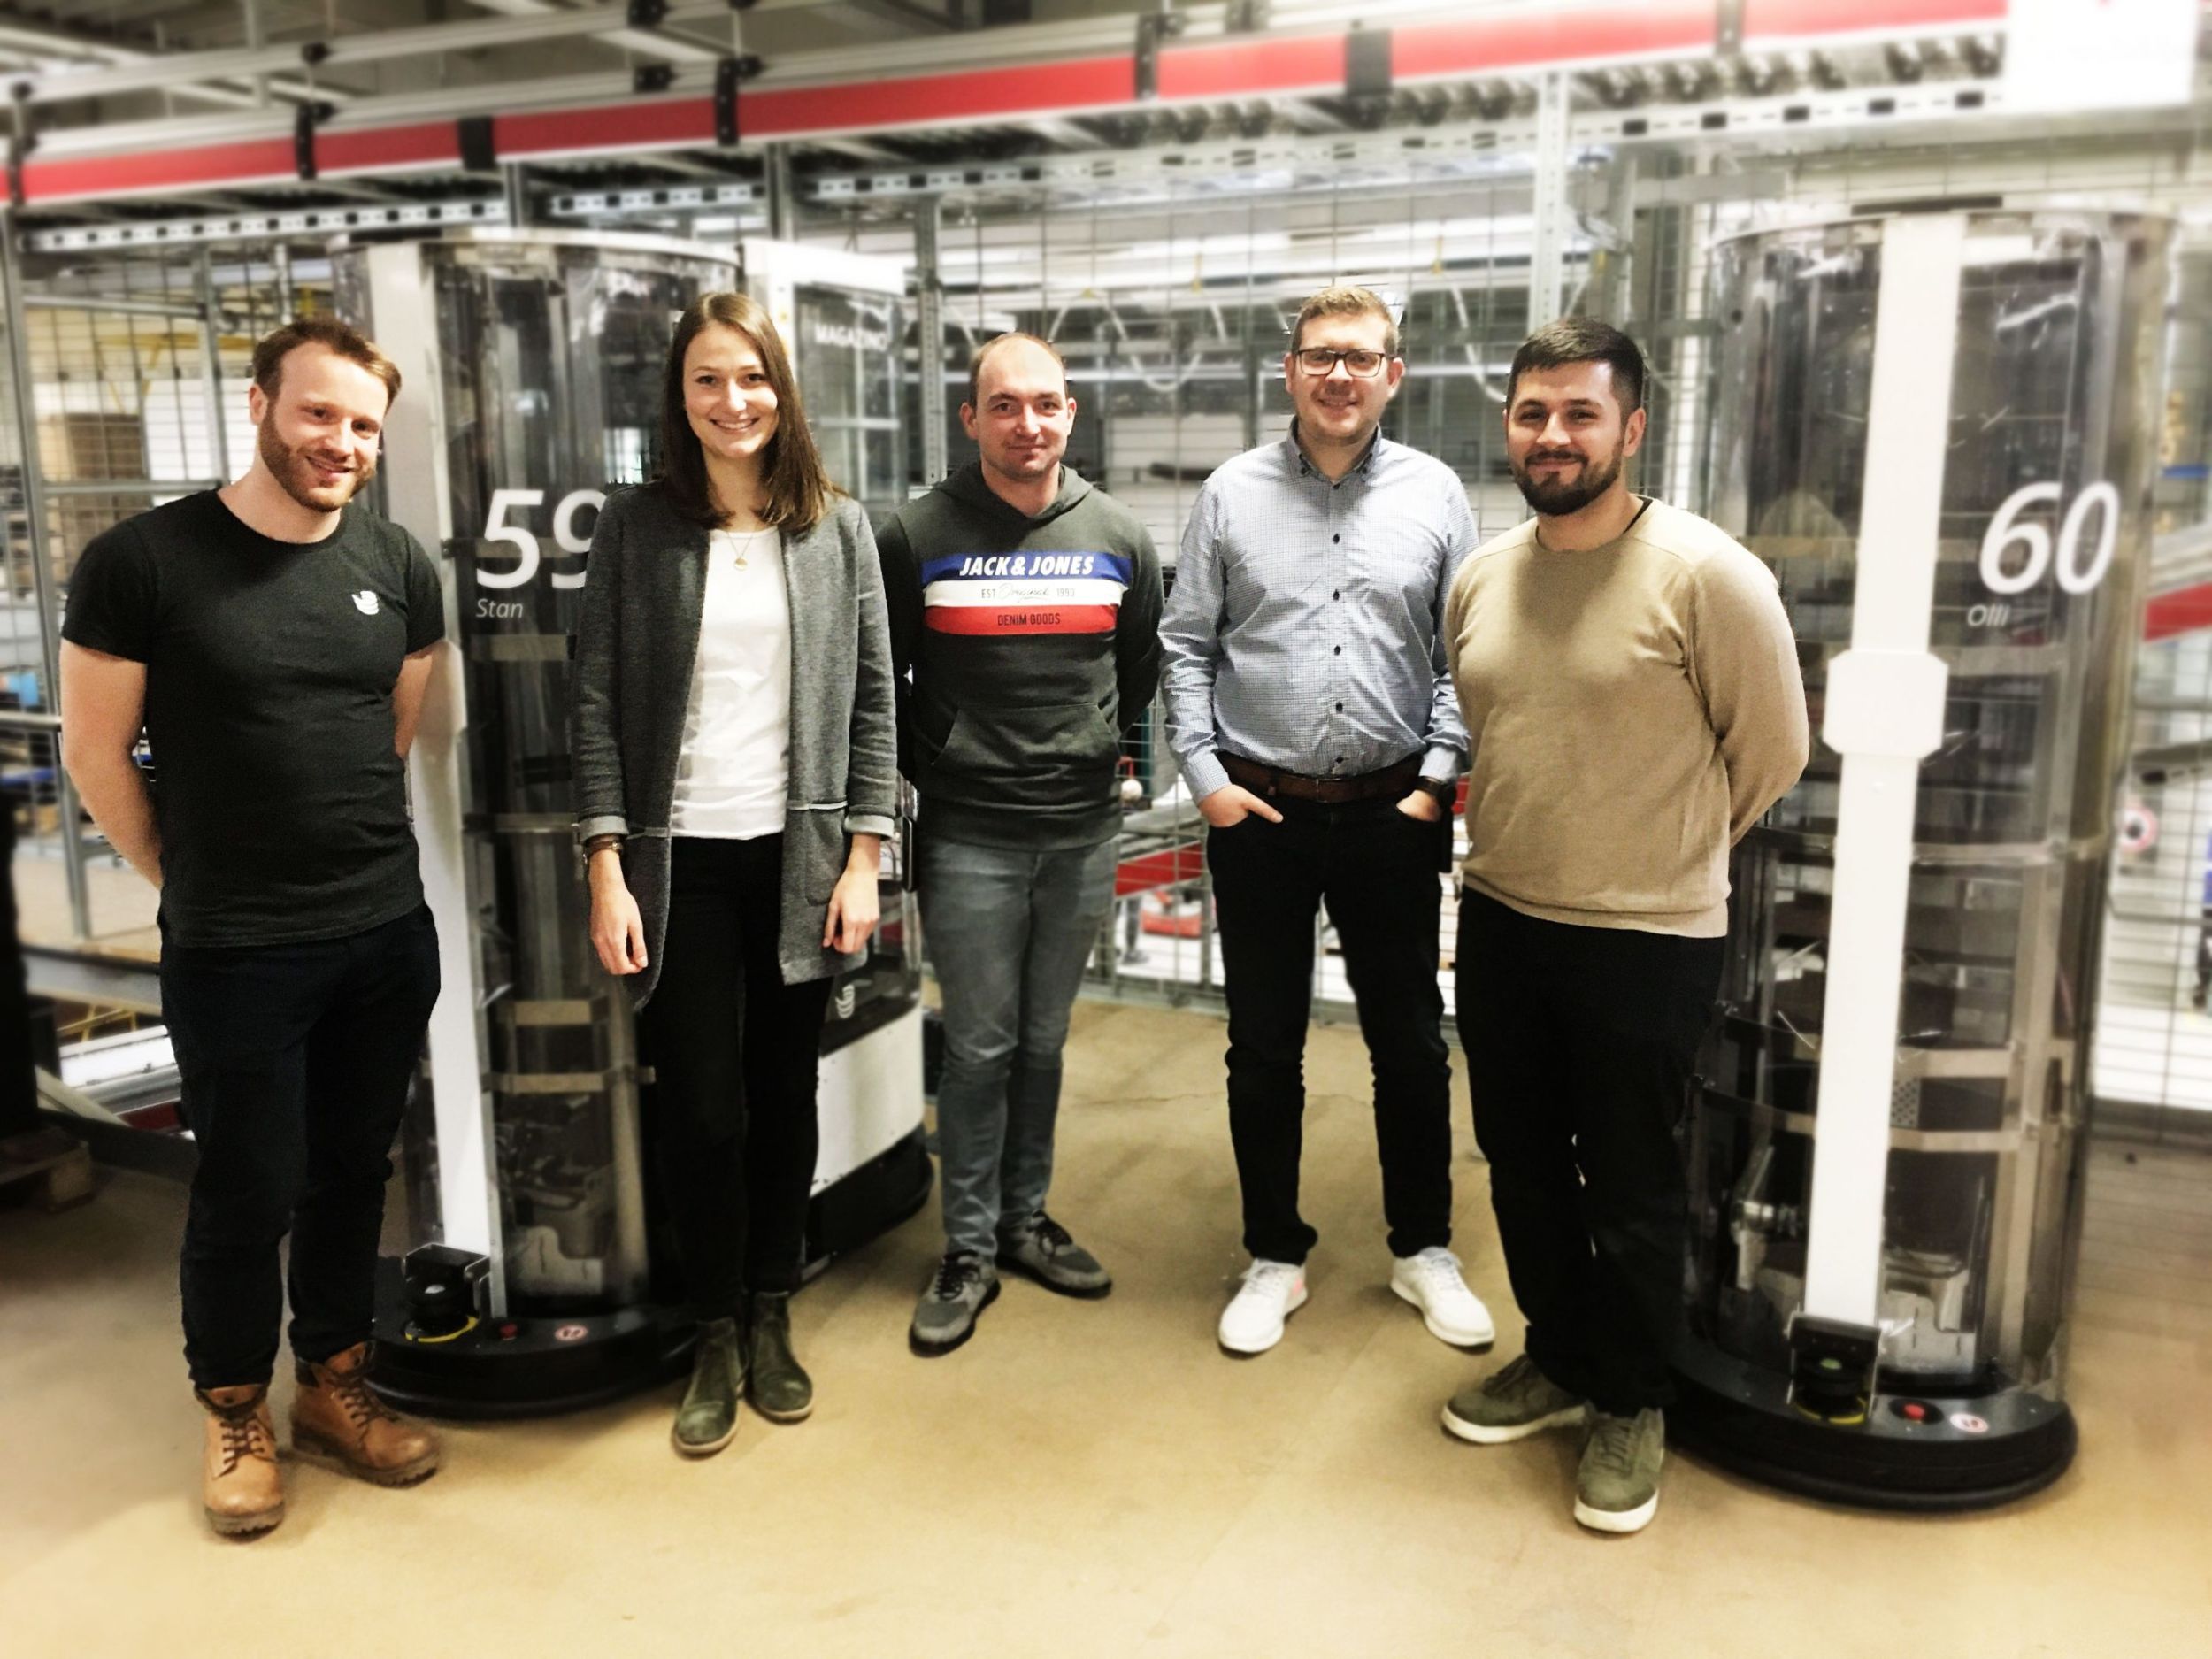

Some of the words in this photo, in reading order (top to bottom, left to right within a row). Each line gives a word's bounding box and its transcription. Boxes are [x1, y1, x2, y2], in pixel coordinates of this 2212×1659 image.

[476, 489, 608, 589] 59
[1979, 481, 2120, 594] 60
[960, 557, 1011, 576] JACK
[1028, 556, 1094, 576] JONES
[981, 588, 995, 599] EST
[475, 598, 524, 618] Stan
[1968, 604, 2010, 626] Olli
[997, 614, 1027, 626] DENIM
[1030, 613, 1061, 625] GOODS
